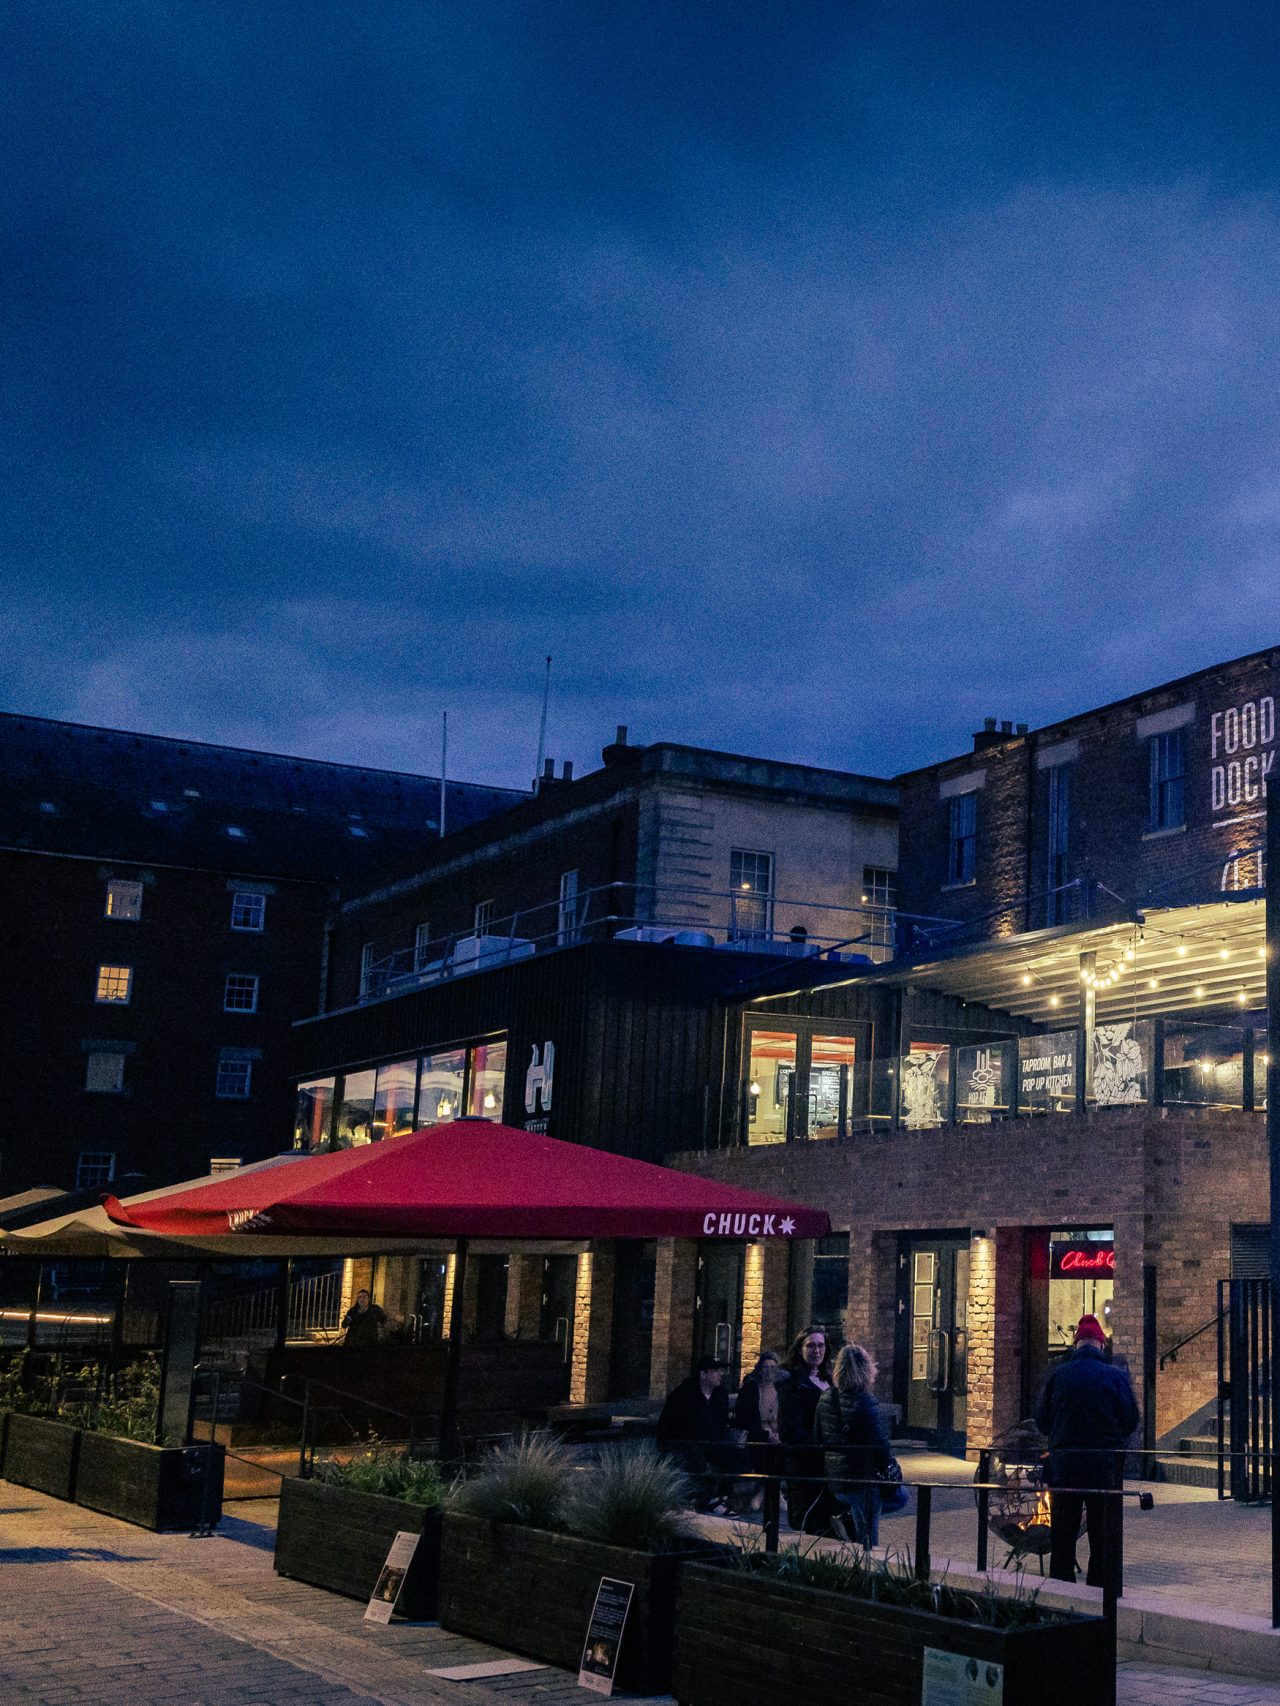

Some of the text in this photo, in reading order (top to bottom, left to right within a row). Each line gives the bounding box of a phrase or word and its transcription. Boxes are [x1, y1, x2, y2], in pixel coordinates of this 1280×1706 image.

[1211, 696, 1275, 759] FOOD
[1053, 1054, 1066, 1069] BAR
[1022, 1073, 1073, 1092] POP UP KITCHEN
[703, 1213, 776, 1235] CHUCK
